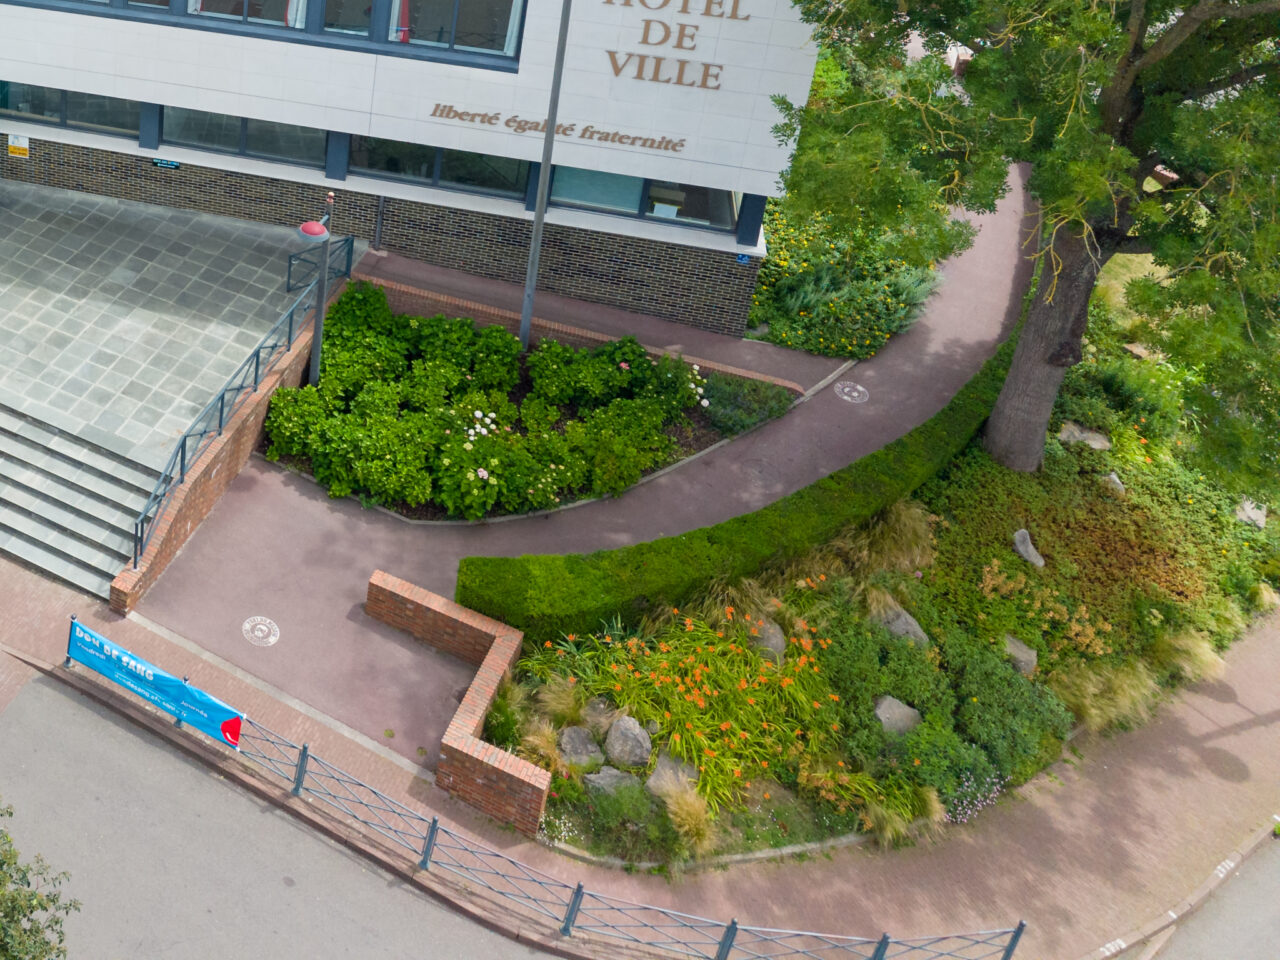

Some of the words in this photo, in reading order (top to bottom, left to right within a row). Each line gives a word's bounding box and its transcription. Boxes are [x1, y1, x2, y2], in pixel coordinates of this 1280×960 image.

[638, 19, 699, 51] DE
[605, 50, 724, 90] VILLE
[430, 103, 501, 125] liberté
[504, 115, 576, 136] égalté
[578, 125, 686, 152] fraternité
[121, 655, 154, 681] SANG
